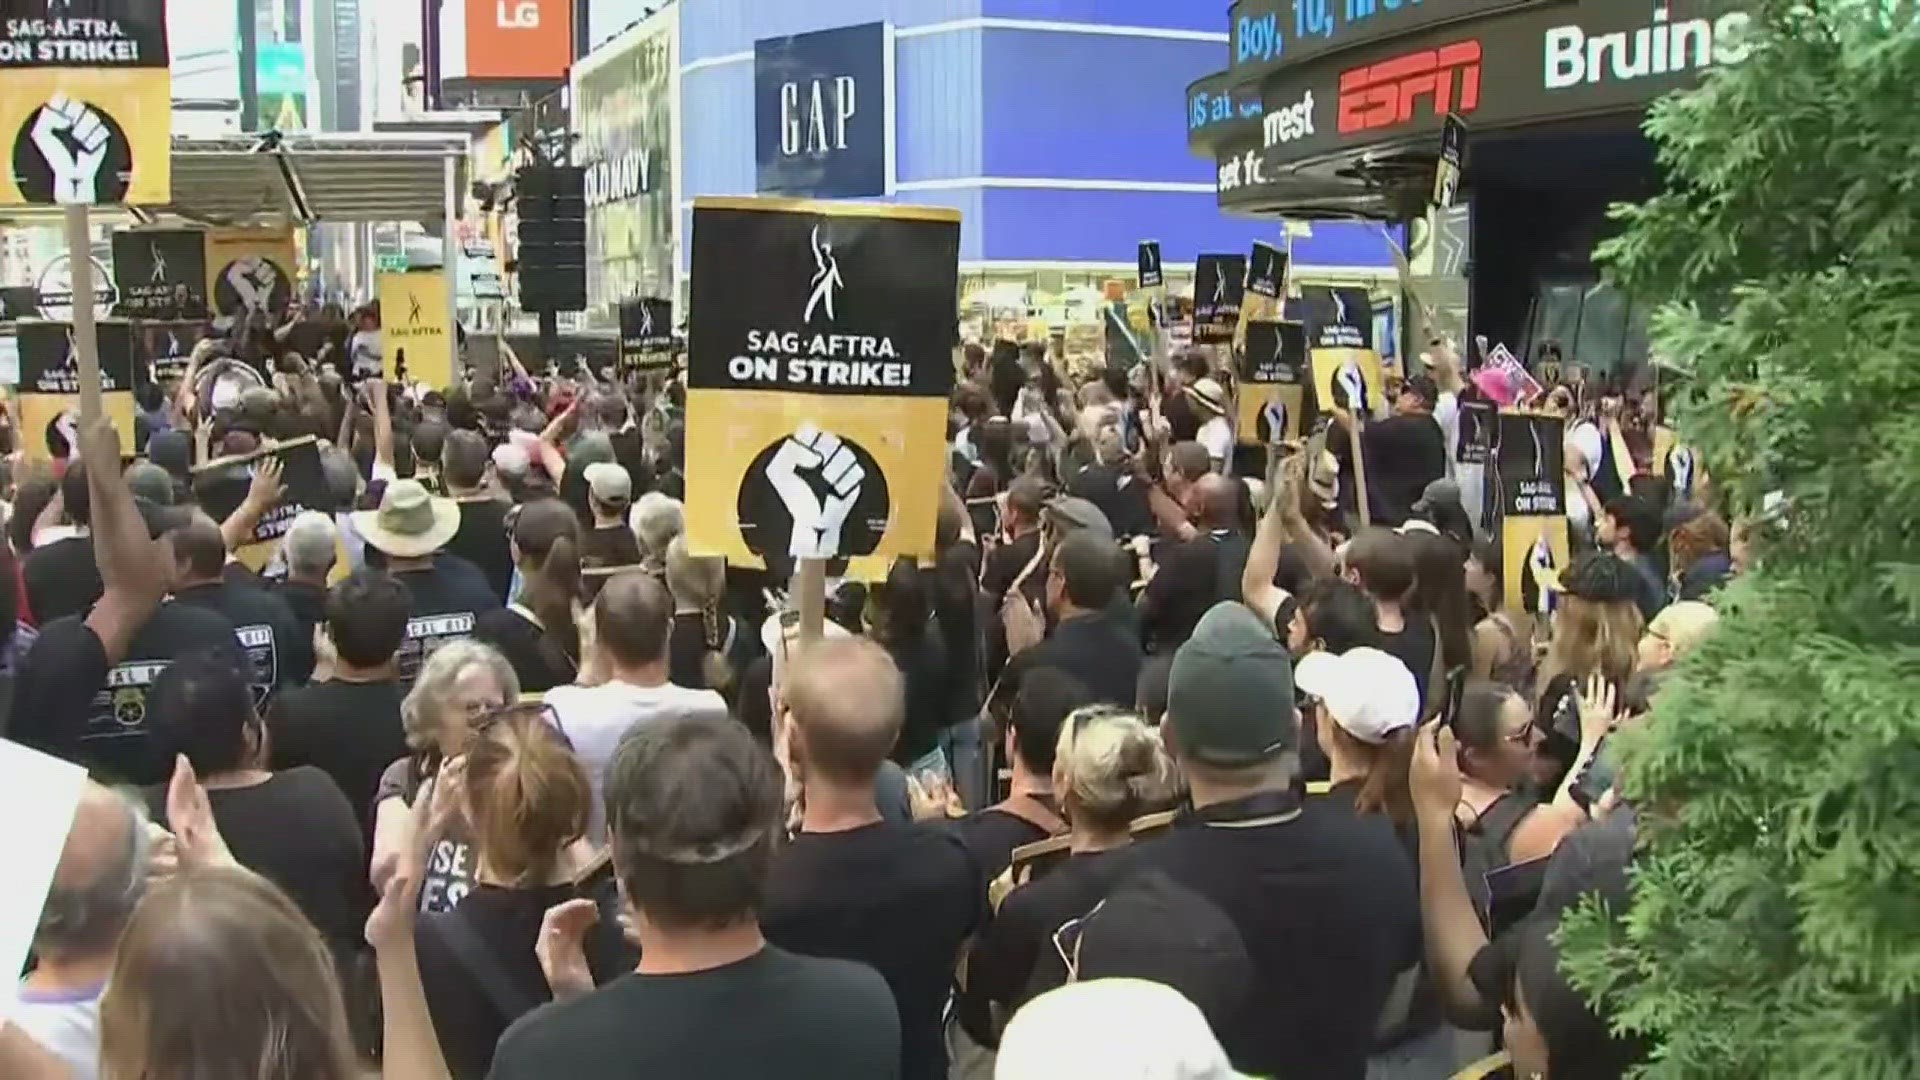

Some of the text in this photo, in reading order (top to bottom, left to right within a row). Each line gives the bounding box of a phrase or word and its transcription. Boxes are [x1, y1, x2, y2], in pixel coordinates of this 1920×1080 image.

[497, 0, 539, 27] LG
[1236, 12, 1283, 63] Boy,
[0, 40, 139, 61] ON STRIKE!
[1544, 8, 1750, 90] Bruins
[1337, 38, 1482, 134] ESPN
[781, 76, 855, 155] GAP
[610, 150, 652, 200] NAVY
[728, 356, 912, 387] ON STRIKE!
